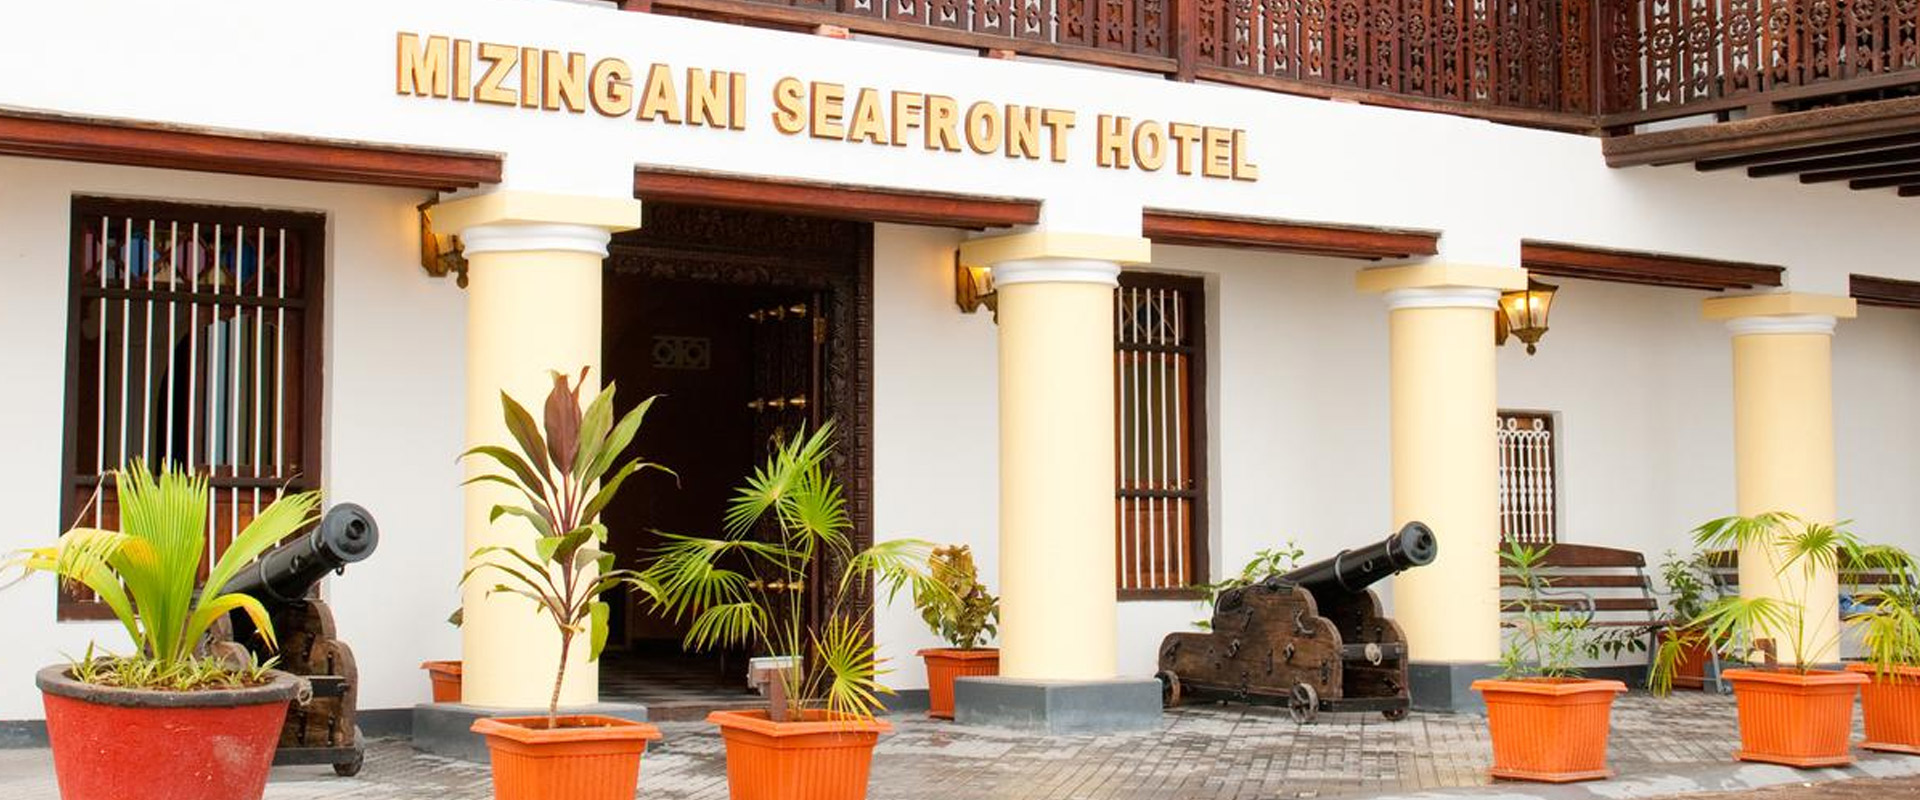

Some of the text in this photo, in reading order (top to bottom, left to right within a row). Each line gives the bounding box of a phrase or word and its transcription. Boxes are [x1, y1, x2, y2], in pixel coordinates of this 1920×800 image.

[396, 31, 1259, 182] MIZINGANI SEAFRONT HOTEL
